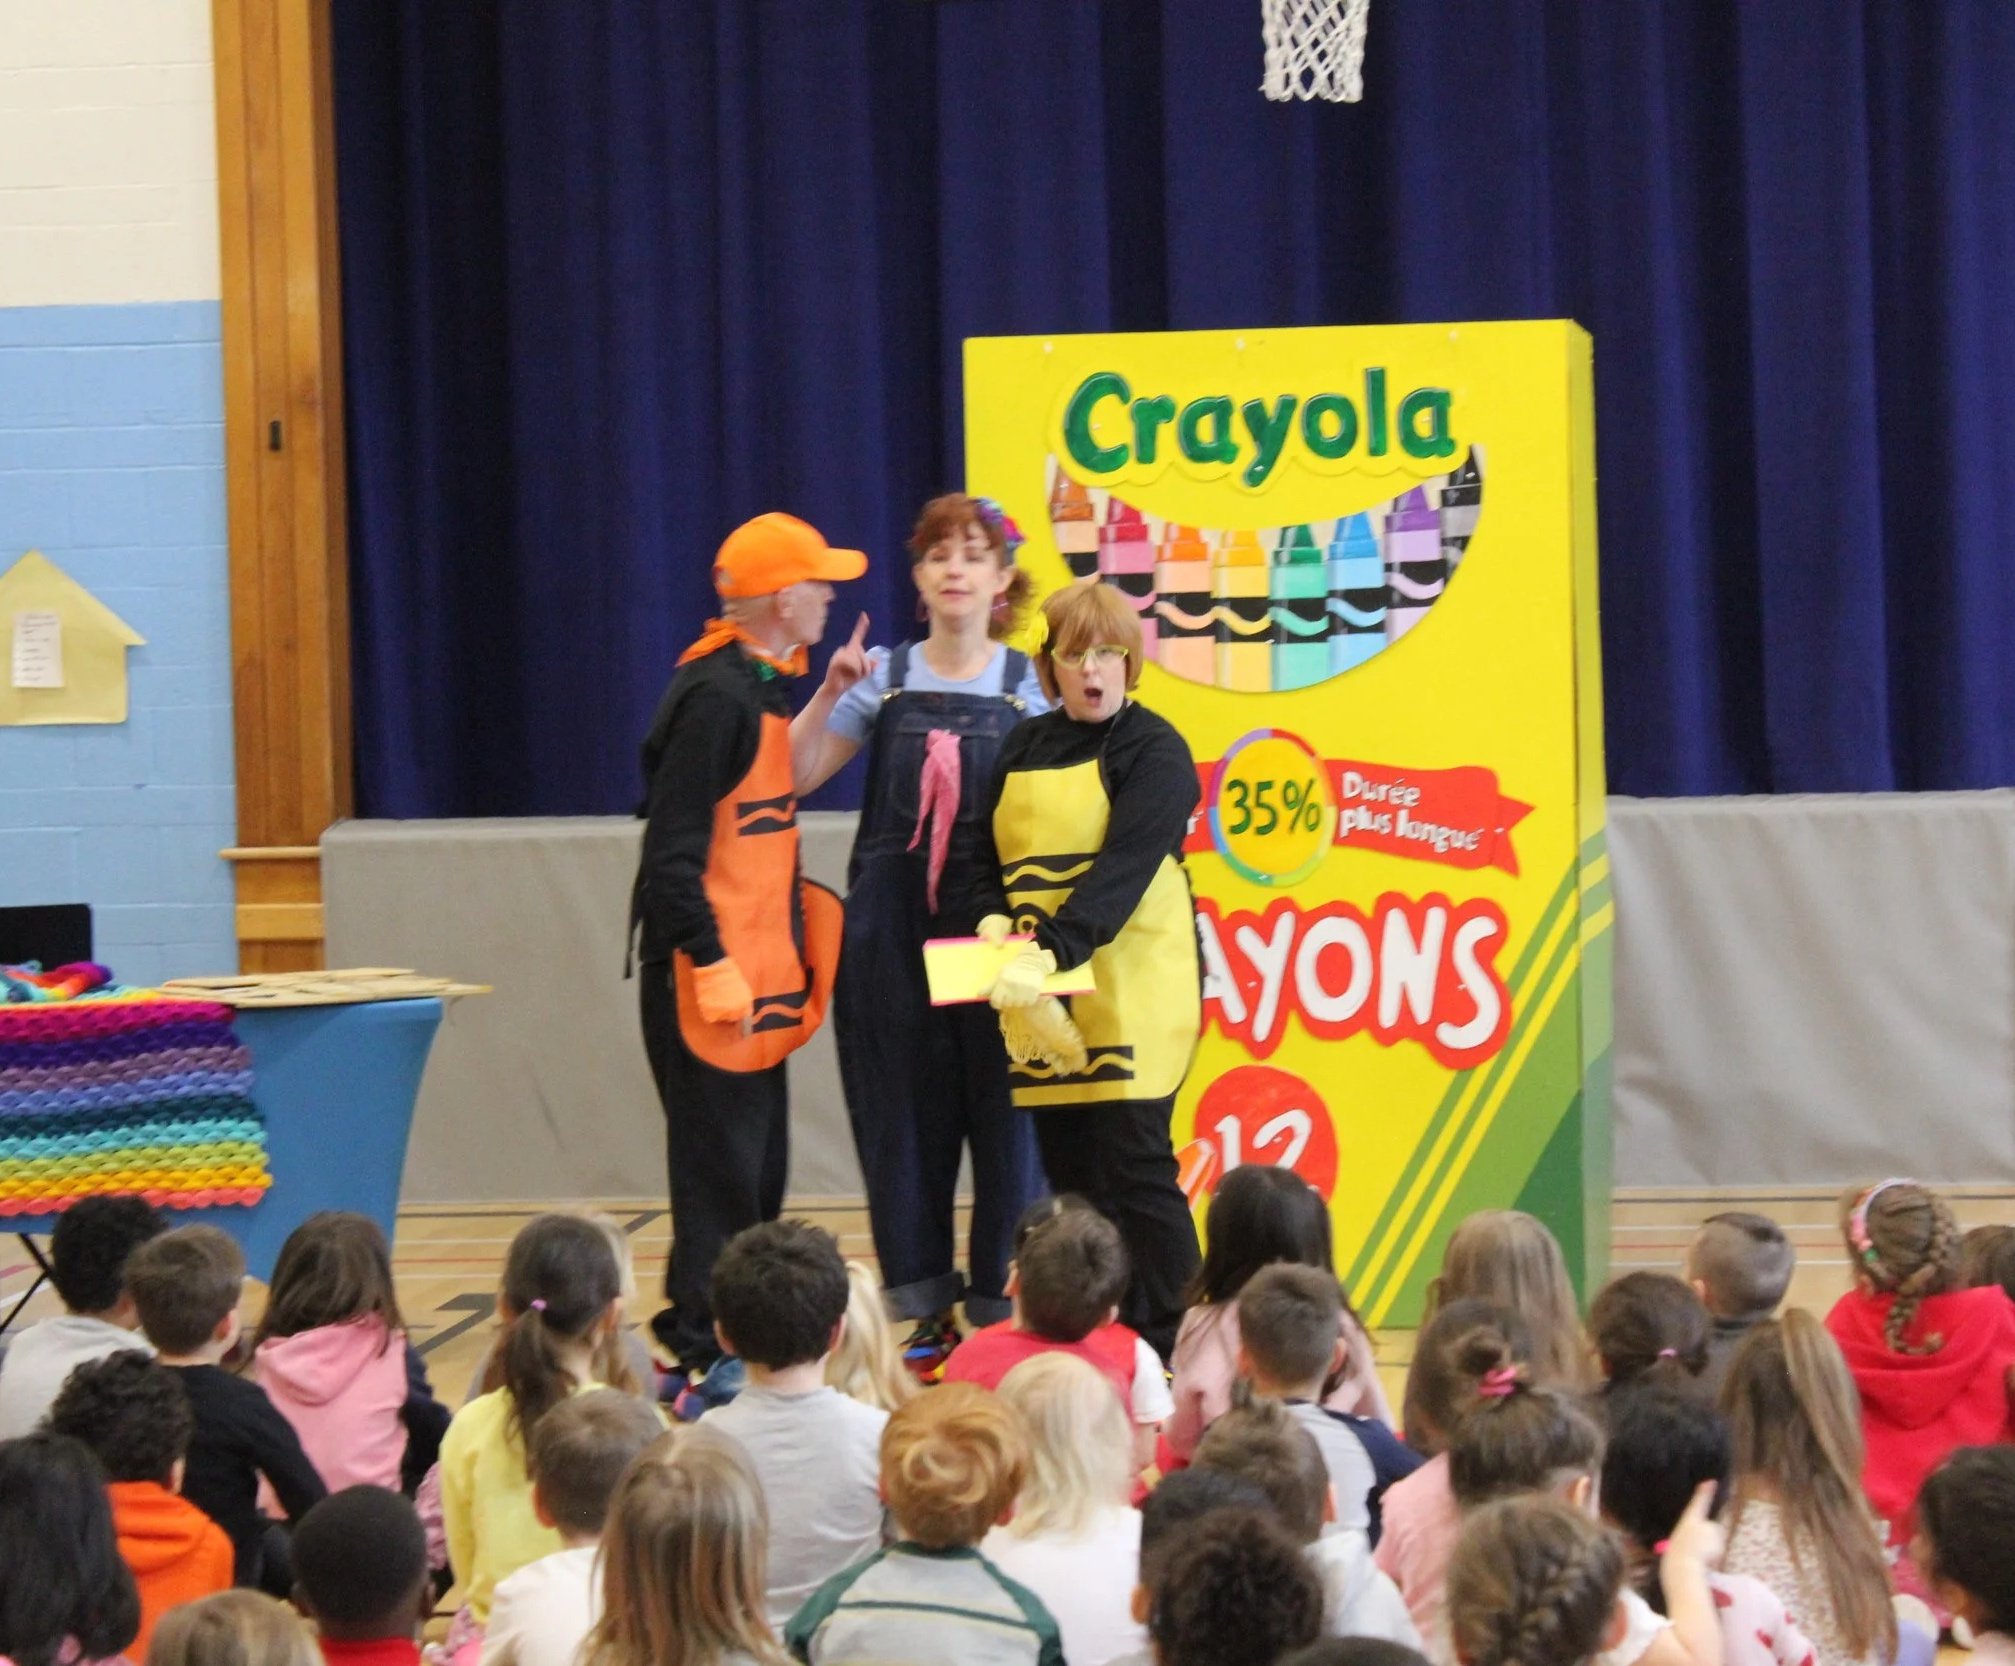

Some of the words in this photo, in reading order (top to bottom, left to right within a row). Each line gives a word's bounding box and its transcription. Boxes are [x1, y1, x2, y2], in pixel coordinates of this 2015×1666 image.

[1064, 367, 1456, 487] Crayola
[1227, 779, 1322, 837] 35%
[1341, 771, 1420, 807] Durée
[1339, 805, 1392, 838] plus
[1395, 808, 1483, 854] longue
[1196, 906, 1503, 1050] AYONS
